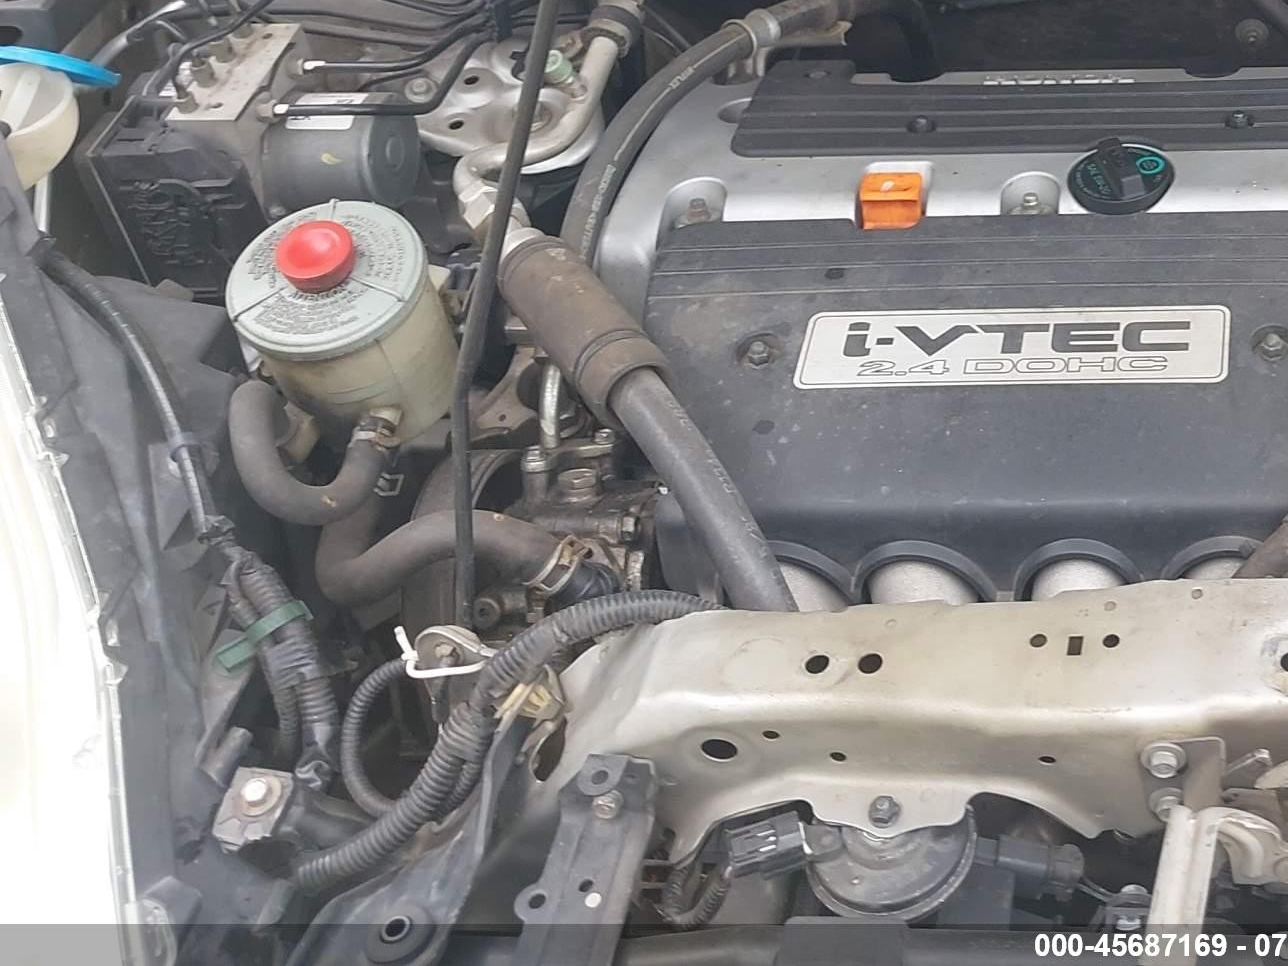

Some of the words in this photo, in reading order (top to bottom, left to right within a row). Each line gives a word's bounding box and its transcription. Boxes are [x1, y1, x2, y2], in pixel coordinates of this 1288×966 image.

[843, 320, 1191, 357] i-VTEC
[857, 356, 949, 376] 2.4
[963, 355, 1169, 375] DOHC
